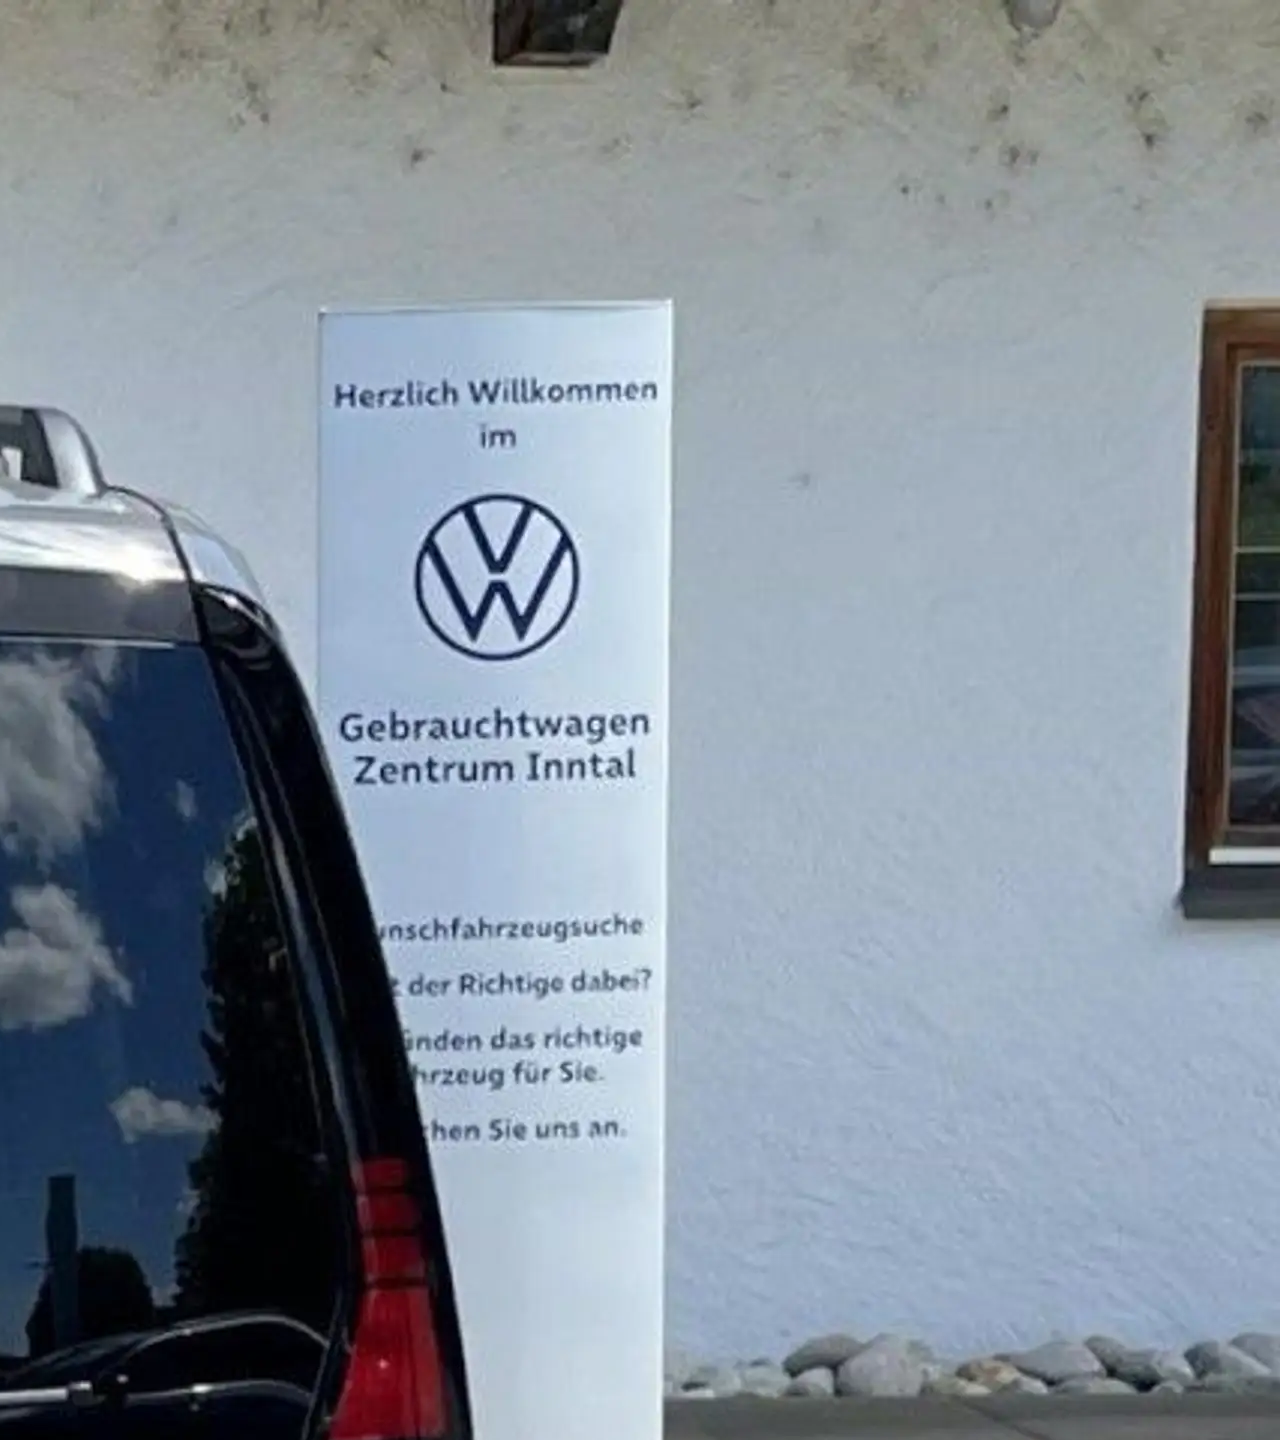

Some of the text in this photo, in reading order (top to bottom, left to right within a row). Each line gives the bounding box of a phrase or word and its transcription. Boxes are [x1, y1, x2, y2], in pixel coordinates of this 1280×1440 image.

[334, 377, 659, 409] Herzlich Willkommen
[480, 423, 517, 449] im
[414, 494, 580, 662] VW
[340, 708, 651, 746] Gebrauchtwagen
[354, 749, 637, 786] Zentrum Inntal
[408, 971, 452, 997] der
[459, 971, 564, 1000] Richtige
[571, 968, 652, 993] dabei?
[490, 1026, 536, 1050] das
[544, 1026, 644, 1054] richtige
[512, 1061, 553, 1084] für
[559, 1060, 606, 1083] Sie.
[489, 1118, 528, 1141] Sie
[535, 1118, 581, 1139] uns
[589, 1118, 629, 1138] an.
